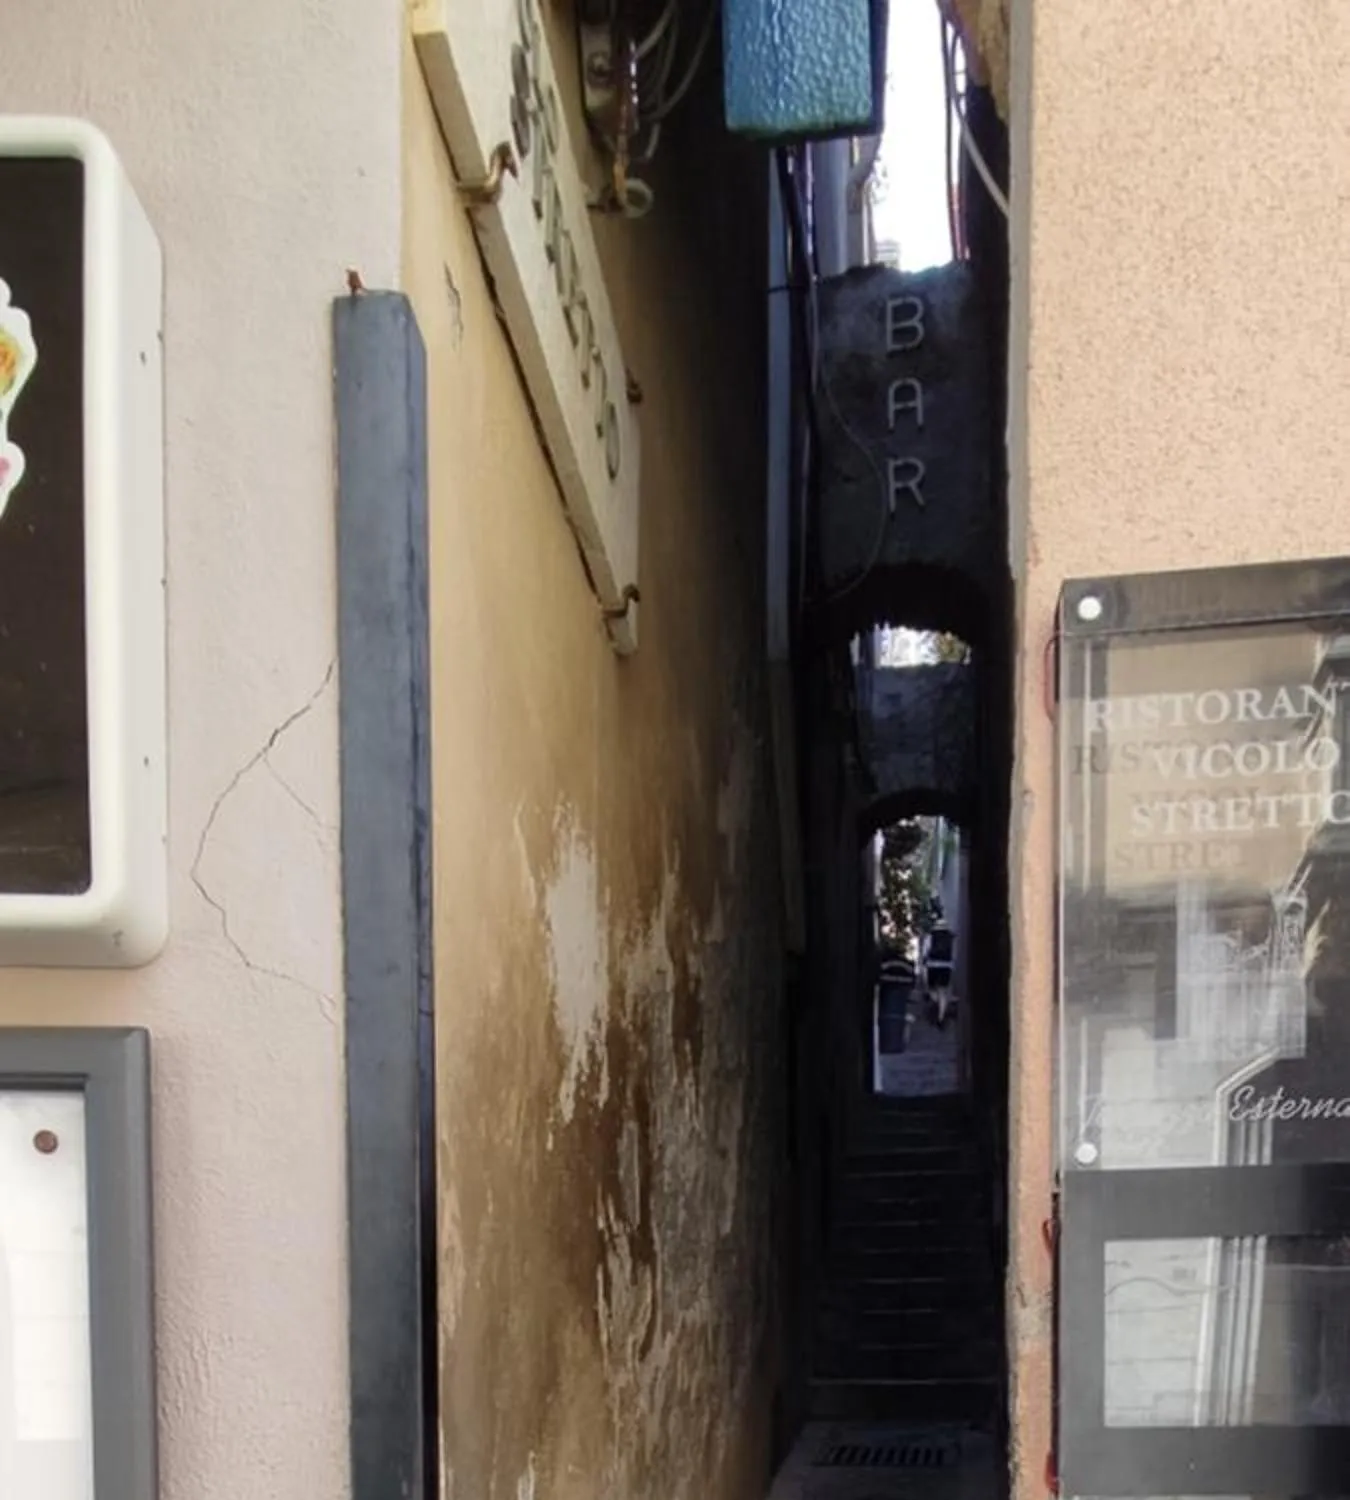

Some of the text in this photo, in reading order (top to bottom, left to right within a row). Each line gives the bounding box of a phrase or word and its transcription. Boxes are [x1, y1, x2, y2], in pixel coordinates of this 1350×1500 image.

[886, 297, 926, 514] BAR
[1152, 736, 1341, 781] VICOLO
[1130, 788, 1350, 837] STRETTO
